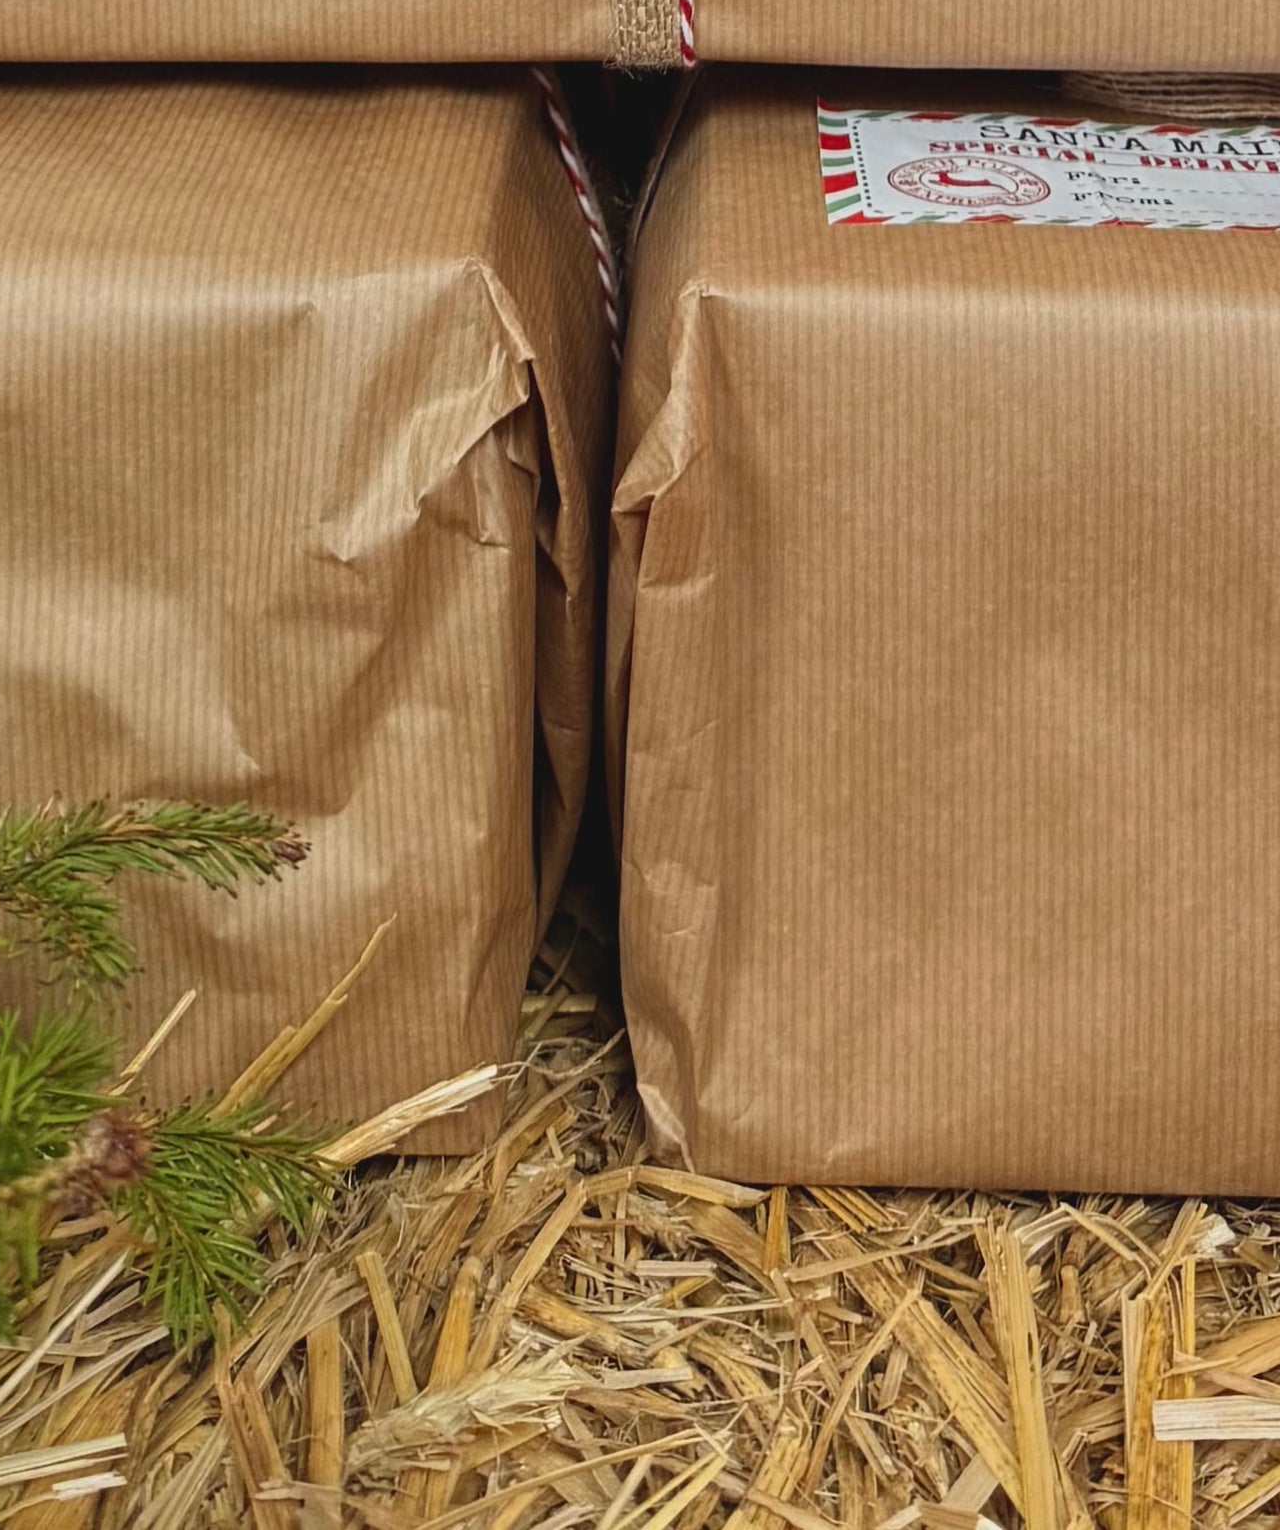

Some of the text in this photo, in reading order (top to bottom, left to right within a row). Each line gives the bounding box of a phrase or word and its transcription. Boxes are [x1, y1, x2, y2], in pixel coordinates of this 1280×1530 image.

[979, 123, 1153, 153] SANTA
[927, 140, 1108, 164] SPECIAL
[1064, 169, 1142, 186] For:
[1068, 191, 1176, 208] From:
